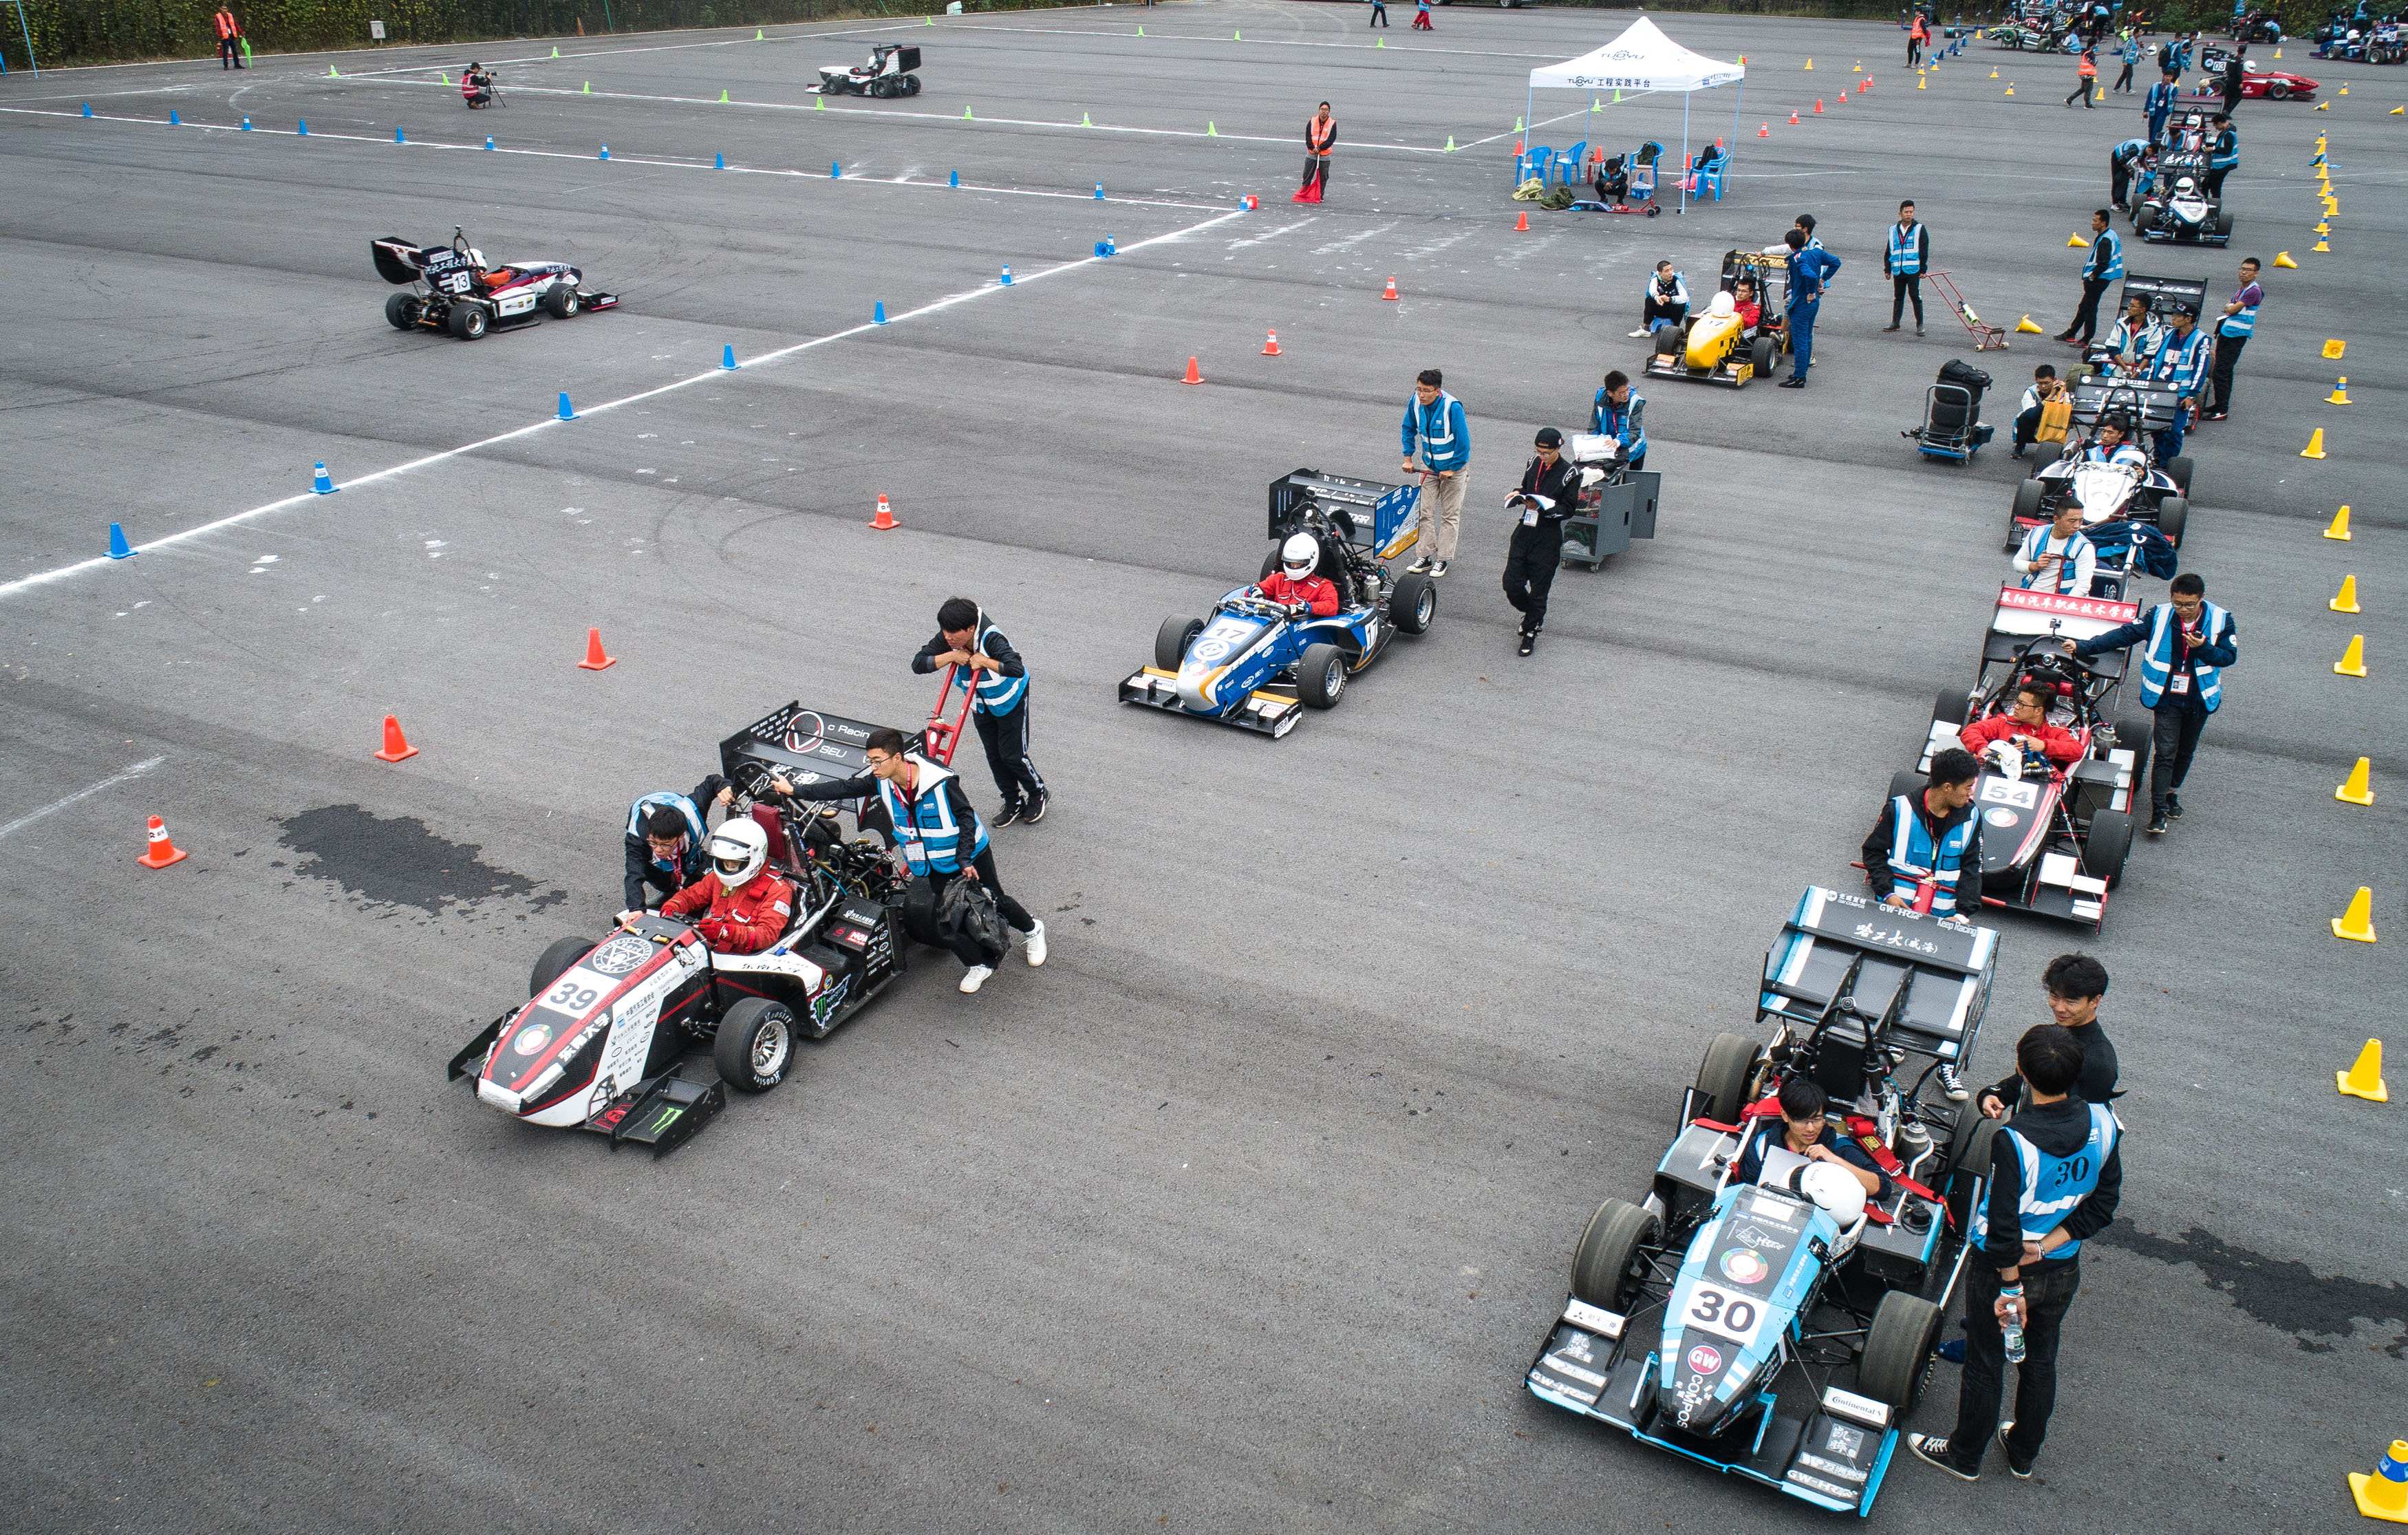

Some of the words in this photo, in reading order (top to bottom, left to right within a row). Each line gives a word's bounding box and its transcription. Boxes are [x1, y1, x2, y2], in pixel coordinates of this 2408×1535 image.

[878, 52, 886, 61] 18
[1600, 50, 1645, 61] TUOYU
[2213, 62, 2226, 70] 03
[1567, 76, 1593, 87] TUOYU
[1597, 78, 1651, 87] 工程实践平台
[455, 275, 468, 289] 13
[2001, 592, 2136, 619] 襄阳汽车职业技术学院
[1216, 627, 1246, 640] 17
[1366, 620, 1377, 647] 17
[837, 724, 871, 739] Racin
[819, 745, 848, 758] SEU
[1988, 785, 2029, 804] 54
[1937, 916, 1955, 930] Keep
[1954, 921, 1978, 938] Racing
[632, 953, 667, 979] Team
[550, 983, 598, 1011] 39
[764, 1009, 792, 1024] Hoosier
[557, 1013, 610, 1062] 东南大学
[753, 1070, 782, 1088] Hoosier
[1864, 1135, 1880, 1149] OMP
[2055, 1156, 2089, 1188] 30
[1690, 1289, 1756, 1333] 30
[1690, 1349, 1719, 1370] GW
[1677, 1374, 1703, 1429] COMPOS
[1831, 1395, 1875, 1416] Continental
